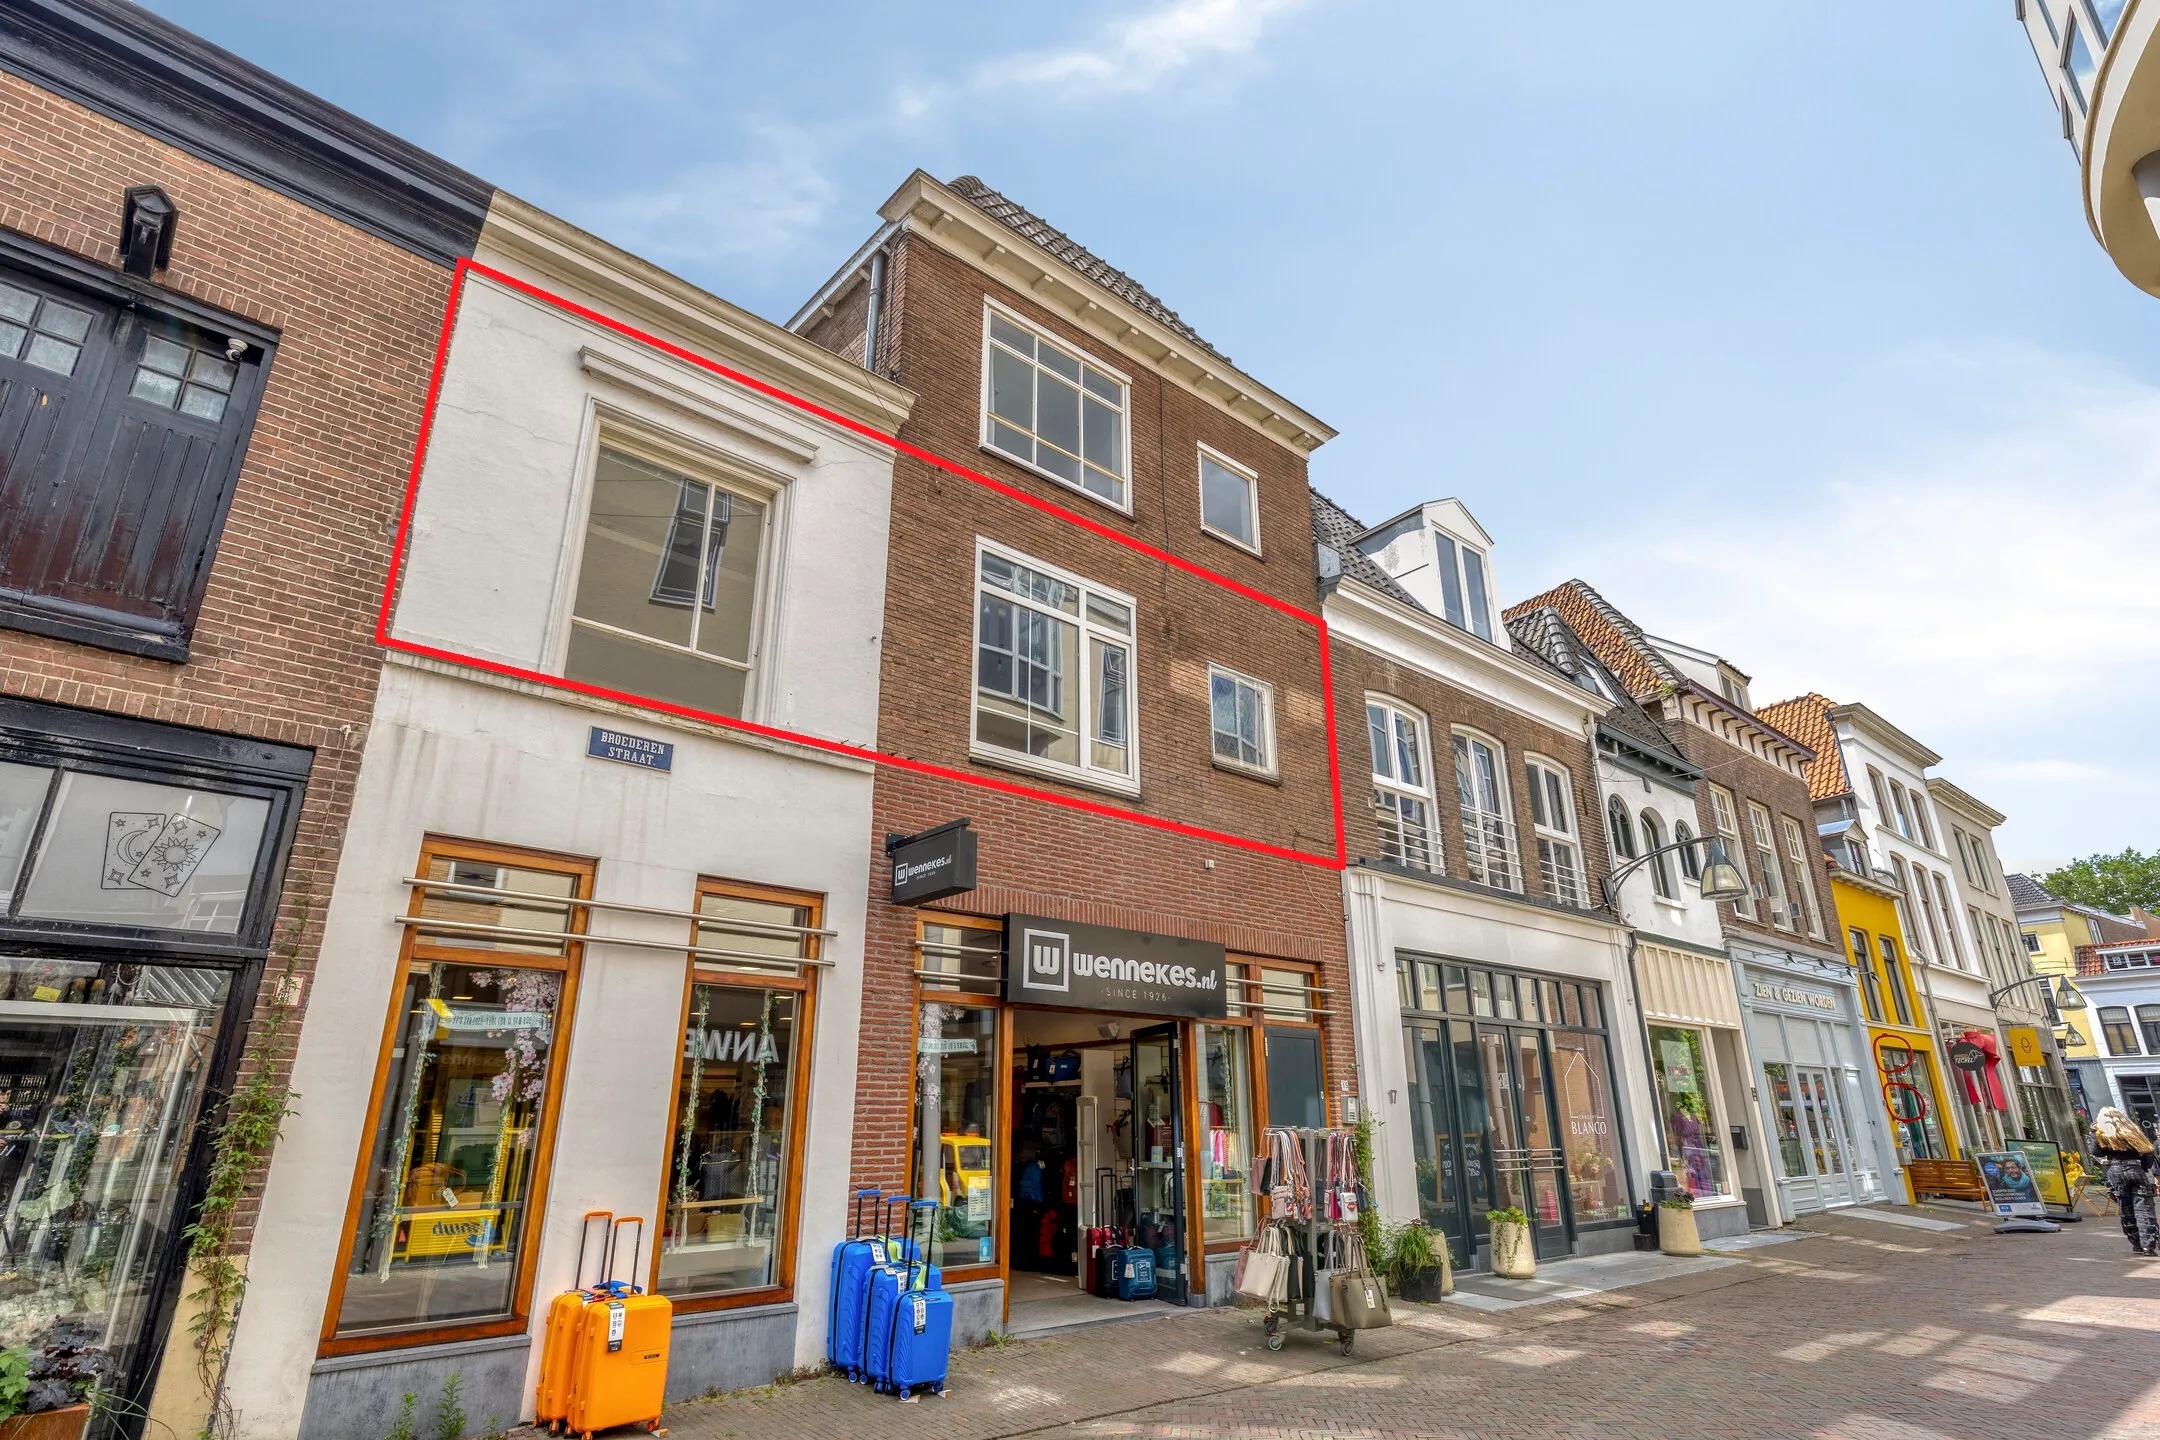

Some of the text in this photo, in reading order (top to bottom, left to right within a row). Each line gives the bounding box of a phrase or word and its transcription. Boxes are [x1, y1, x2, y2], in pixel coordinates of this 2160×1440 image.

[600, 731, 665, 755] BROEDEREN
[1072, 952, 1218, 990] wennekes.nl
[1753, 983, 1836, 1010] ZIEN & GEZIEN WORDEN
[1571, 1121, 1607, 1135] BLANCO
